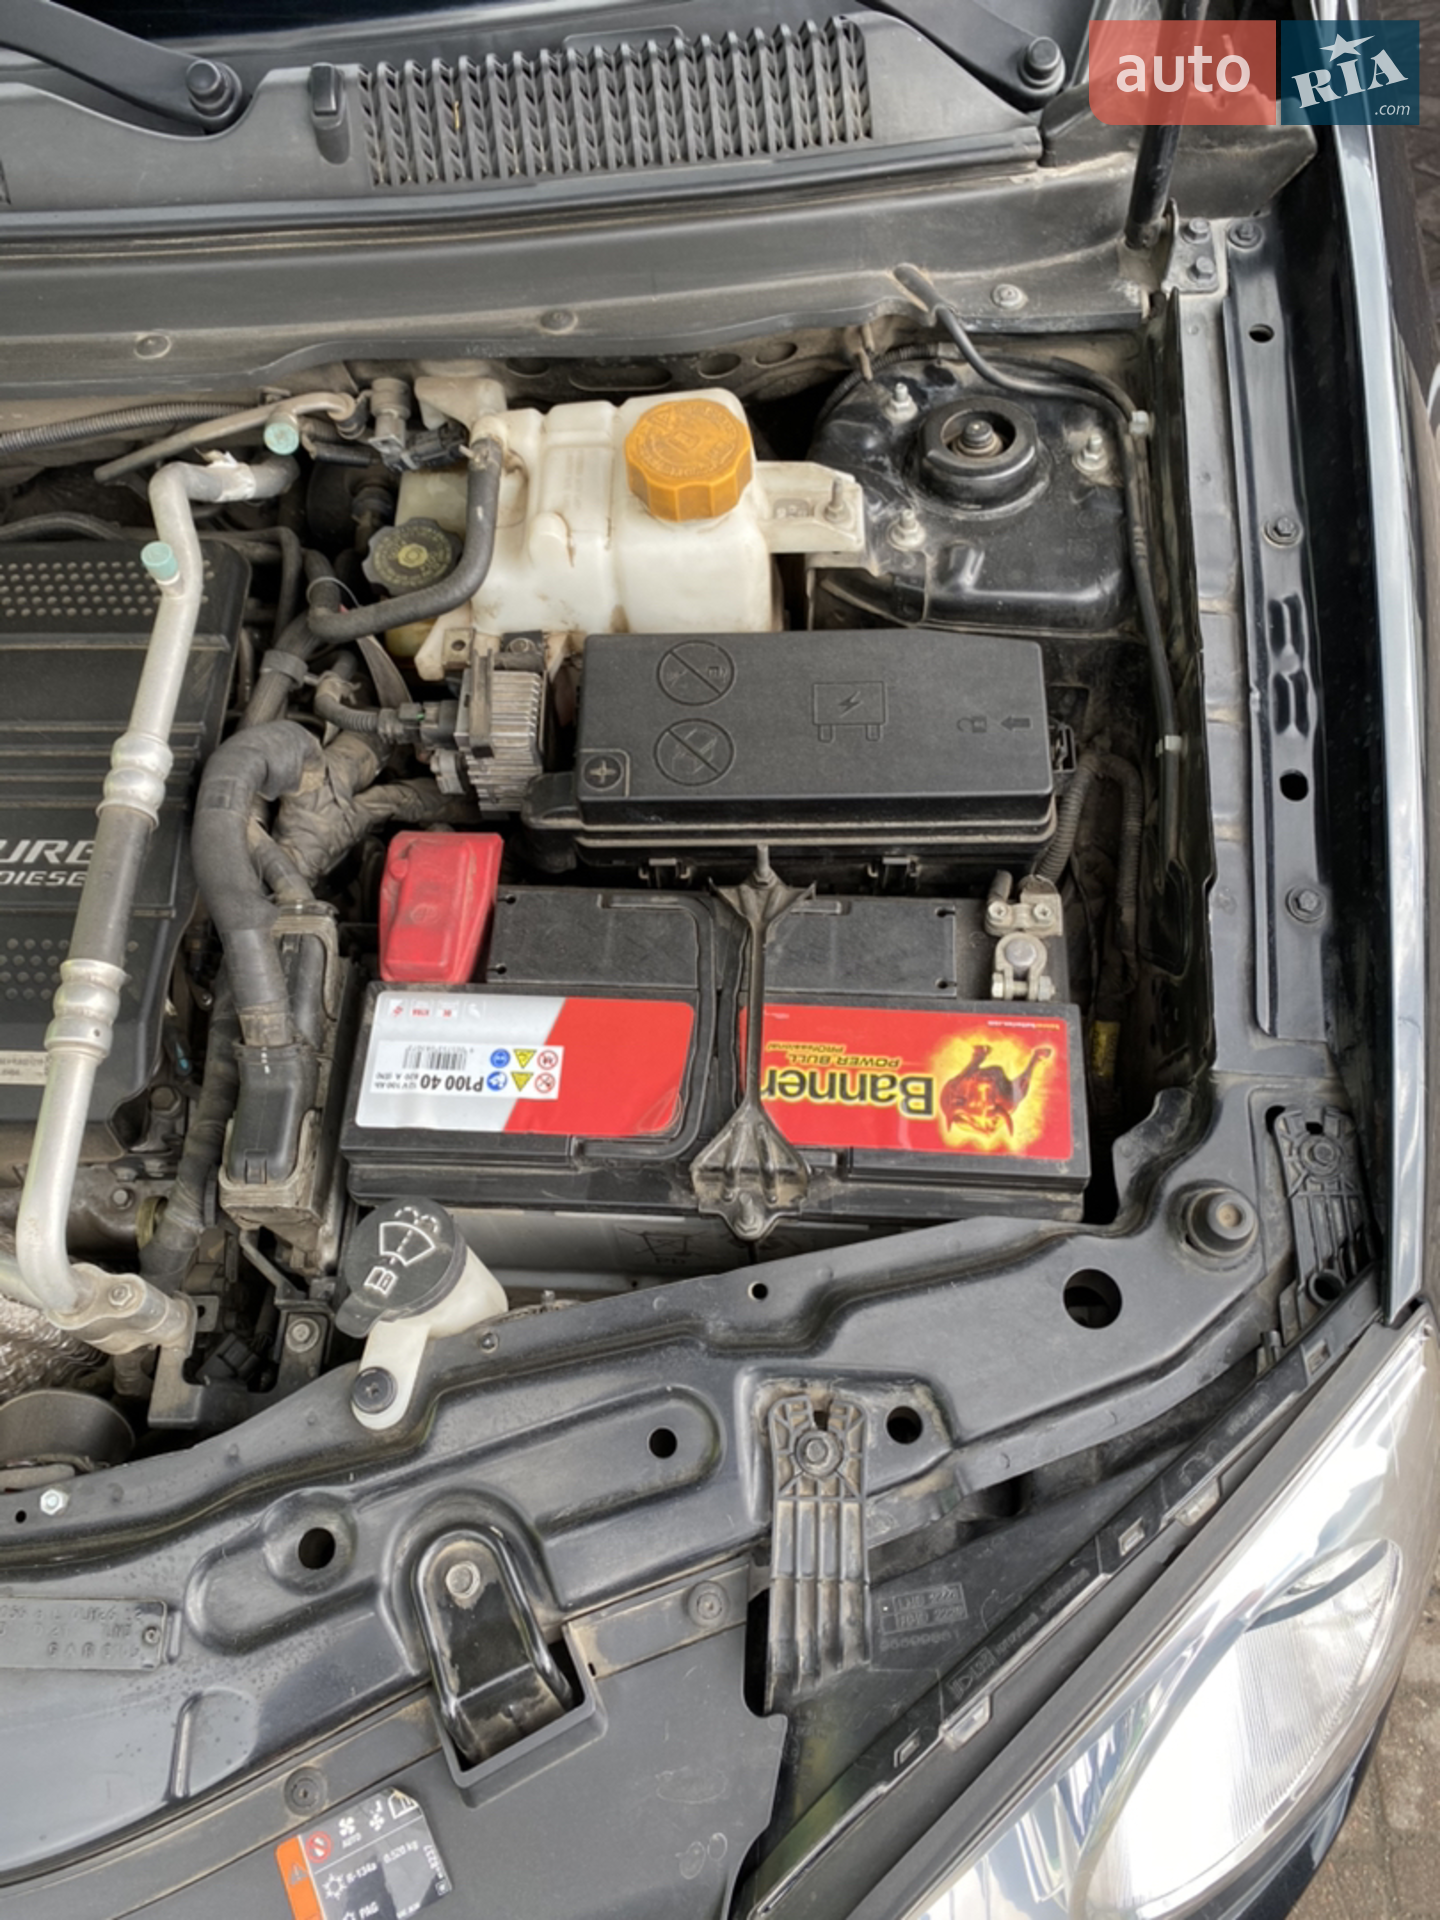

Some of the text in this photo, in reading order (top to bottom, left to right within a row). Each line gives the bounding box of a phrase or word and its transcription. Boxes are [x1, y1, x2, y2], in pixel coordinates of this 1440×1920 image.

[787, 1052, 901, 1070] POWER BULL
[420, 1074, 484, 1093] P100 40
[760, 1067, 935, 1117] Banner
[359, 1901, 379, 1919] PAG
